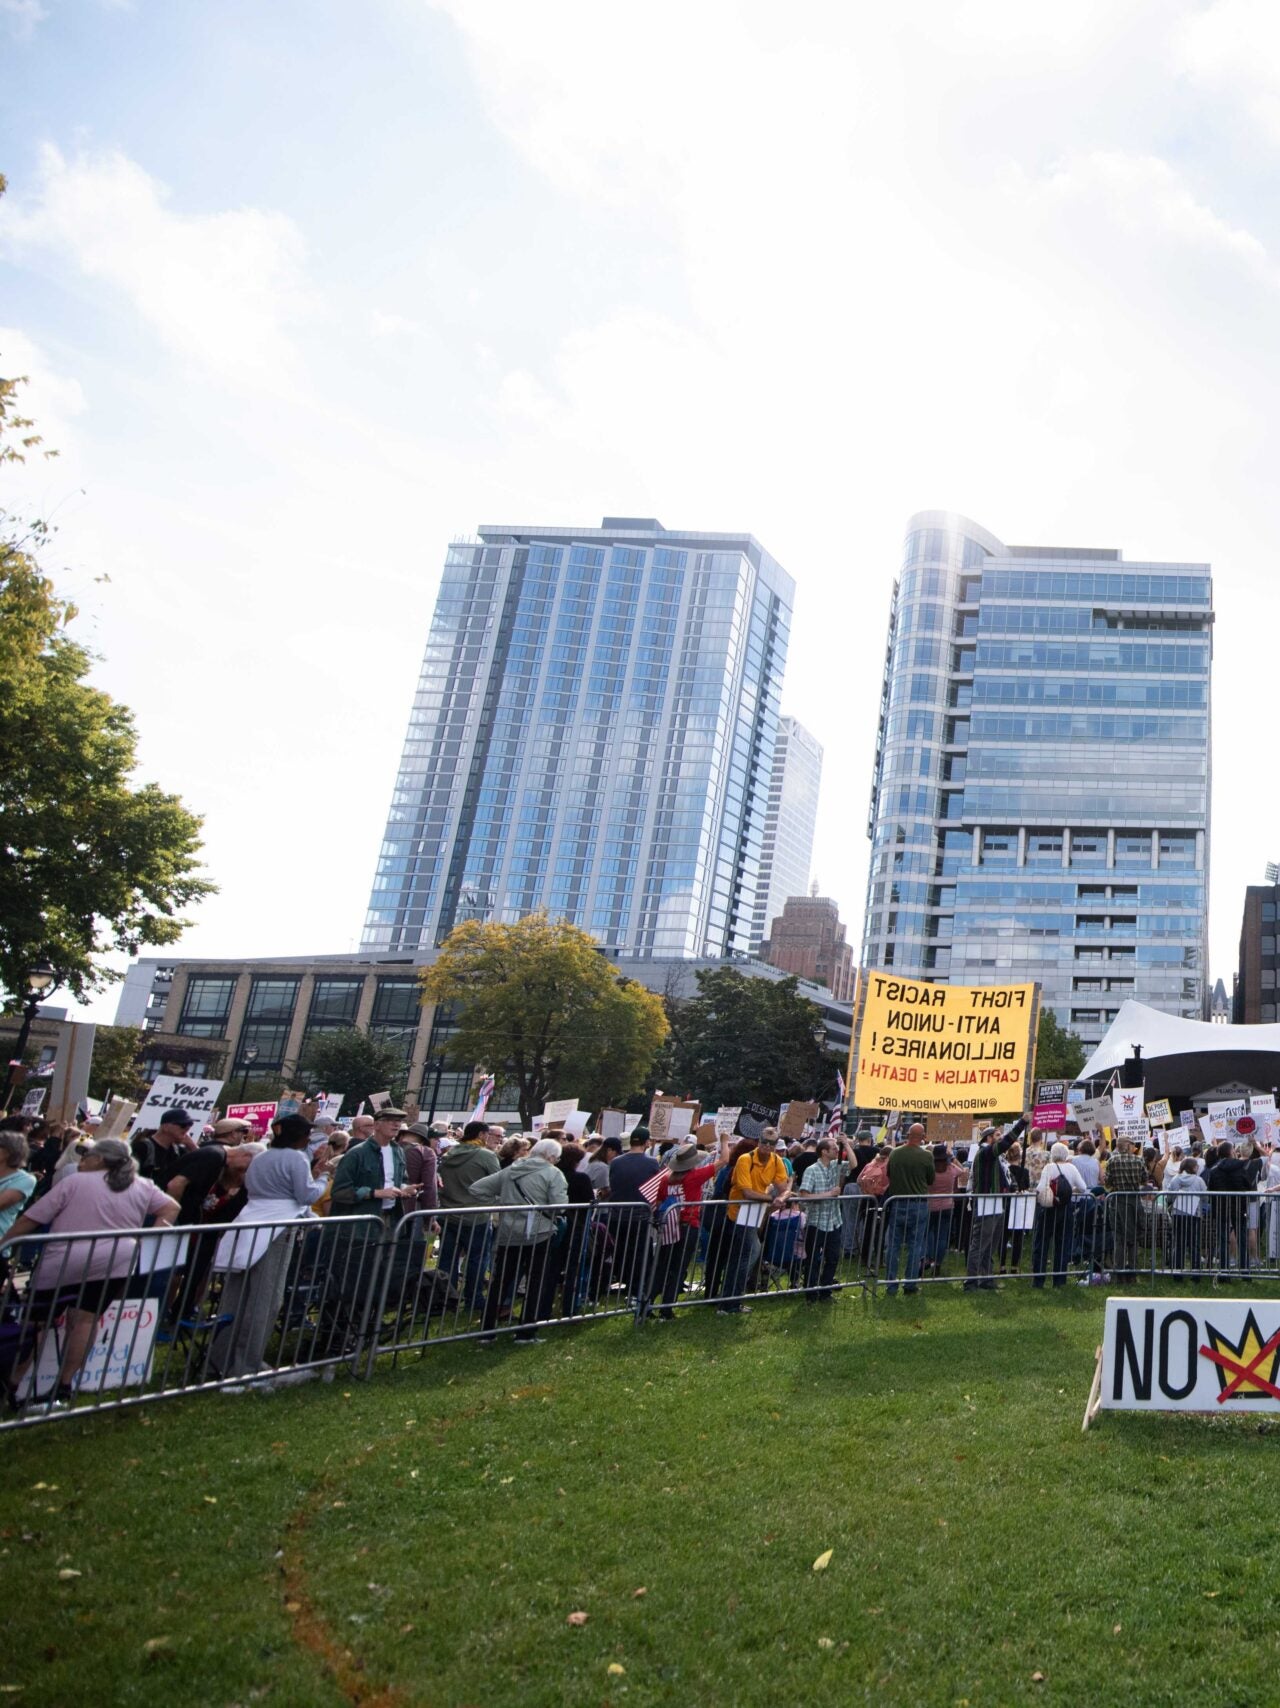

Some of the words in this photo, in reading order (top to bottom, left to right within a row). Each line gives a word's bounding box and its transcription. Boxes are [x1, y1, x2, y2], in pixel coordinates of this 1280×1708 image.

[172, 1081, 209, 1097] YOUR
[146, 1095, 215, 1112] SILENCE
[231, 1107, 246, 1115] WE
[247, 1104, 274, 1113] BACK
[745, 1101, 751, 1109] I
[751, 1102, 778, 1119] DISSENT
[667, 1184, 684, 1196] WE
[1113, 1307, 1198, 1401] NO
